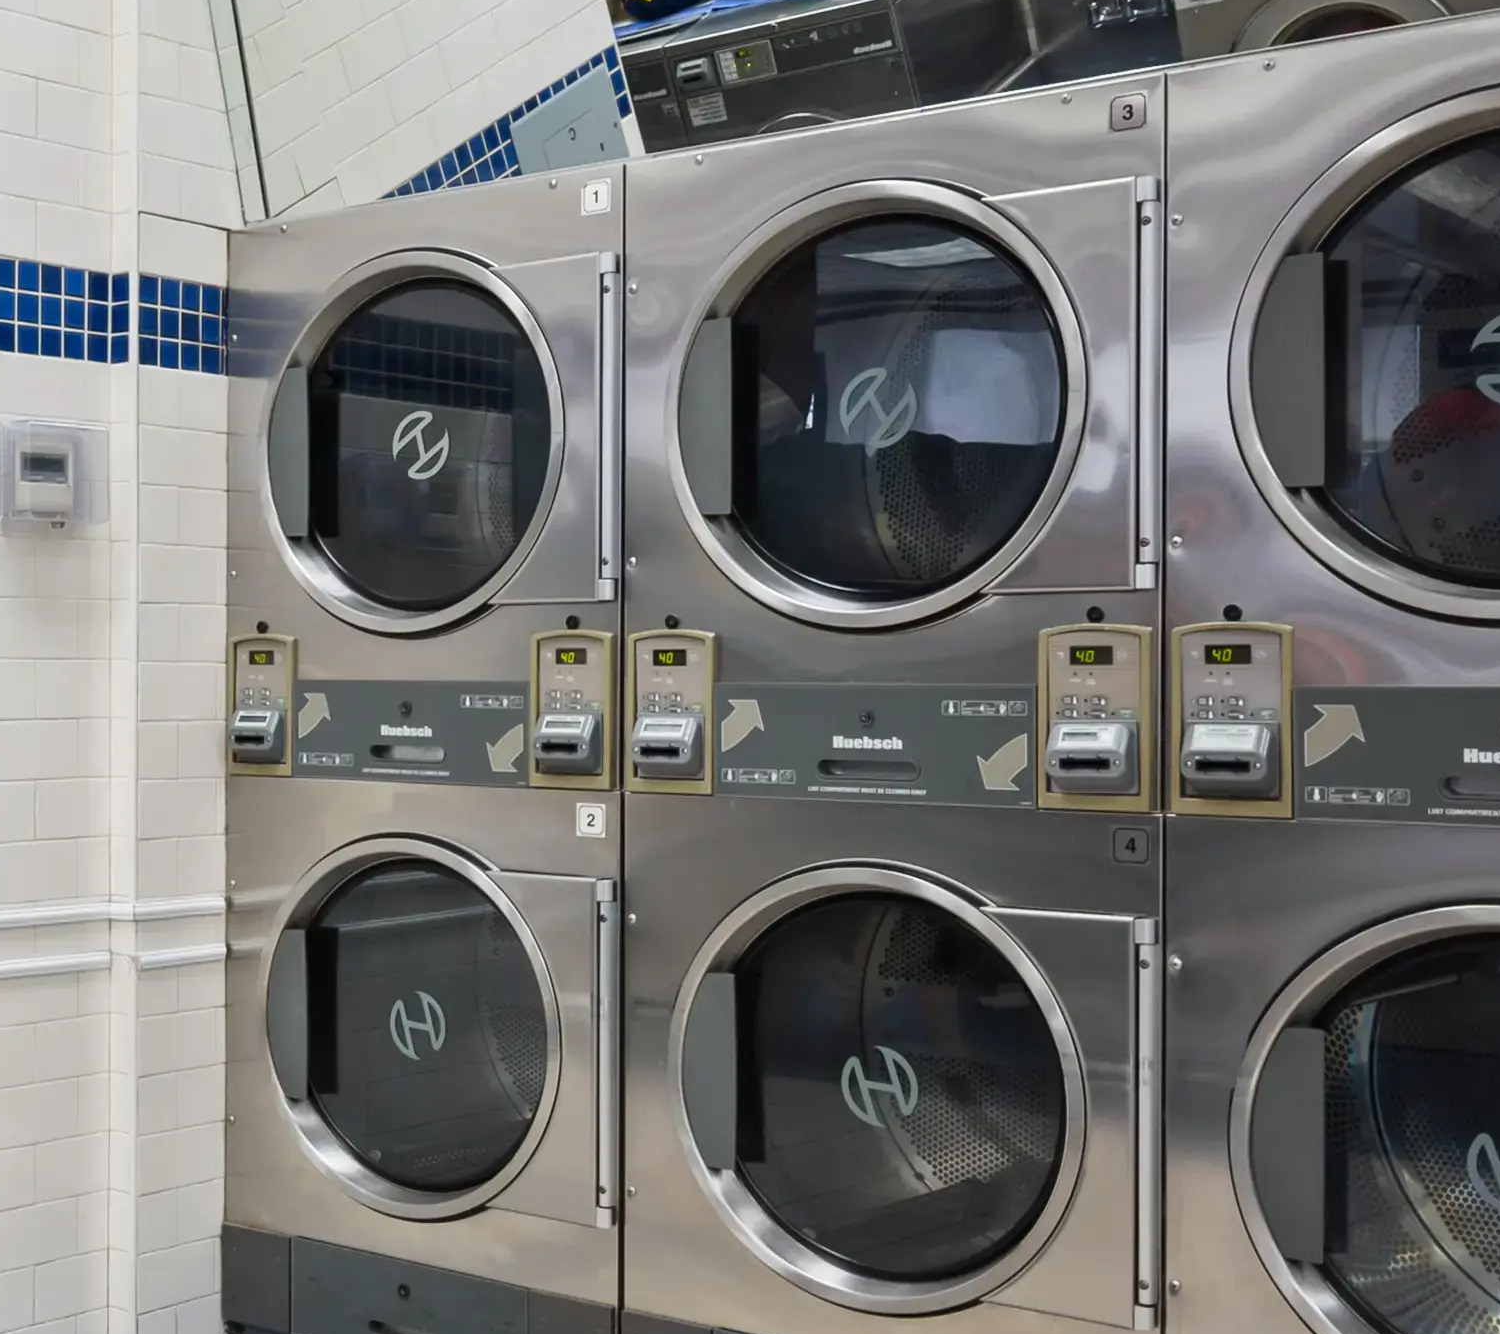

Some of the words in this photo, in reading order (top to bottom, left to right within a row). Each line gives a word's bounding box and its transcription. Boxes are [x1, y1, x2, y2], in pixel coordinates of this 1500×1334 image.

[1121, 103, 1134, 121] 3
[591, 189, 601, 205] 1
[254, 652, 267, 663] 40
[560, 651, 576, 664] 40
[658, 651, 675, 665] 40
[1075, 649, 1095, 663] 40
[1211, 646, 1232, 662] 40
[380, 723, 433, 739] Huebsch
[832, 735, 903, 751] Huebsch
[585, 812, 596, 829] 2
[1124, 836, 1138, 855] 4
